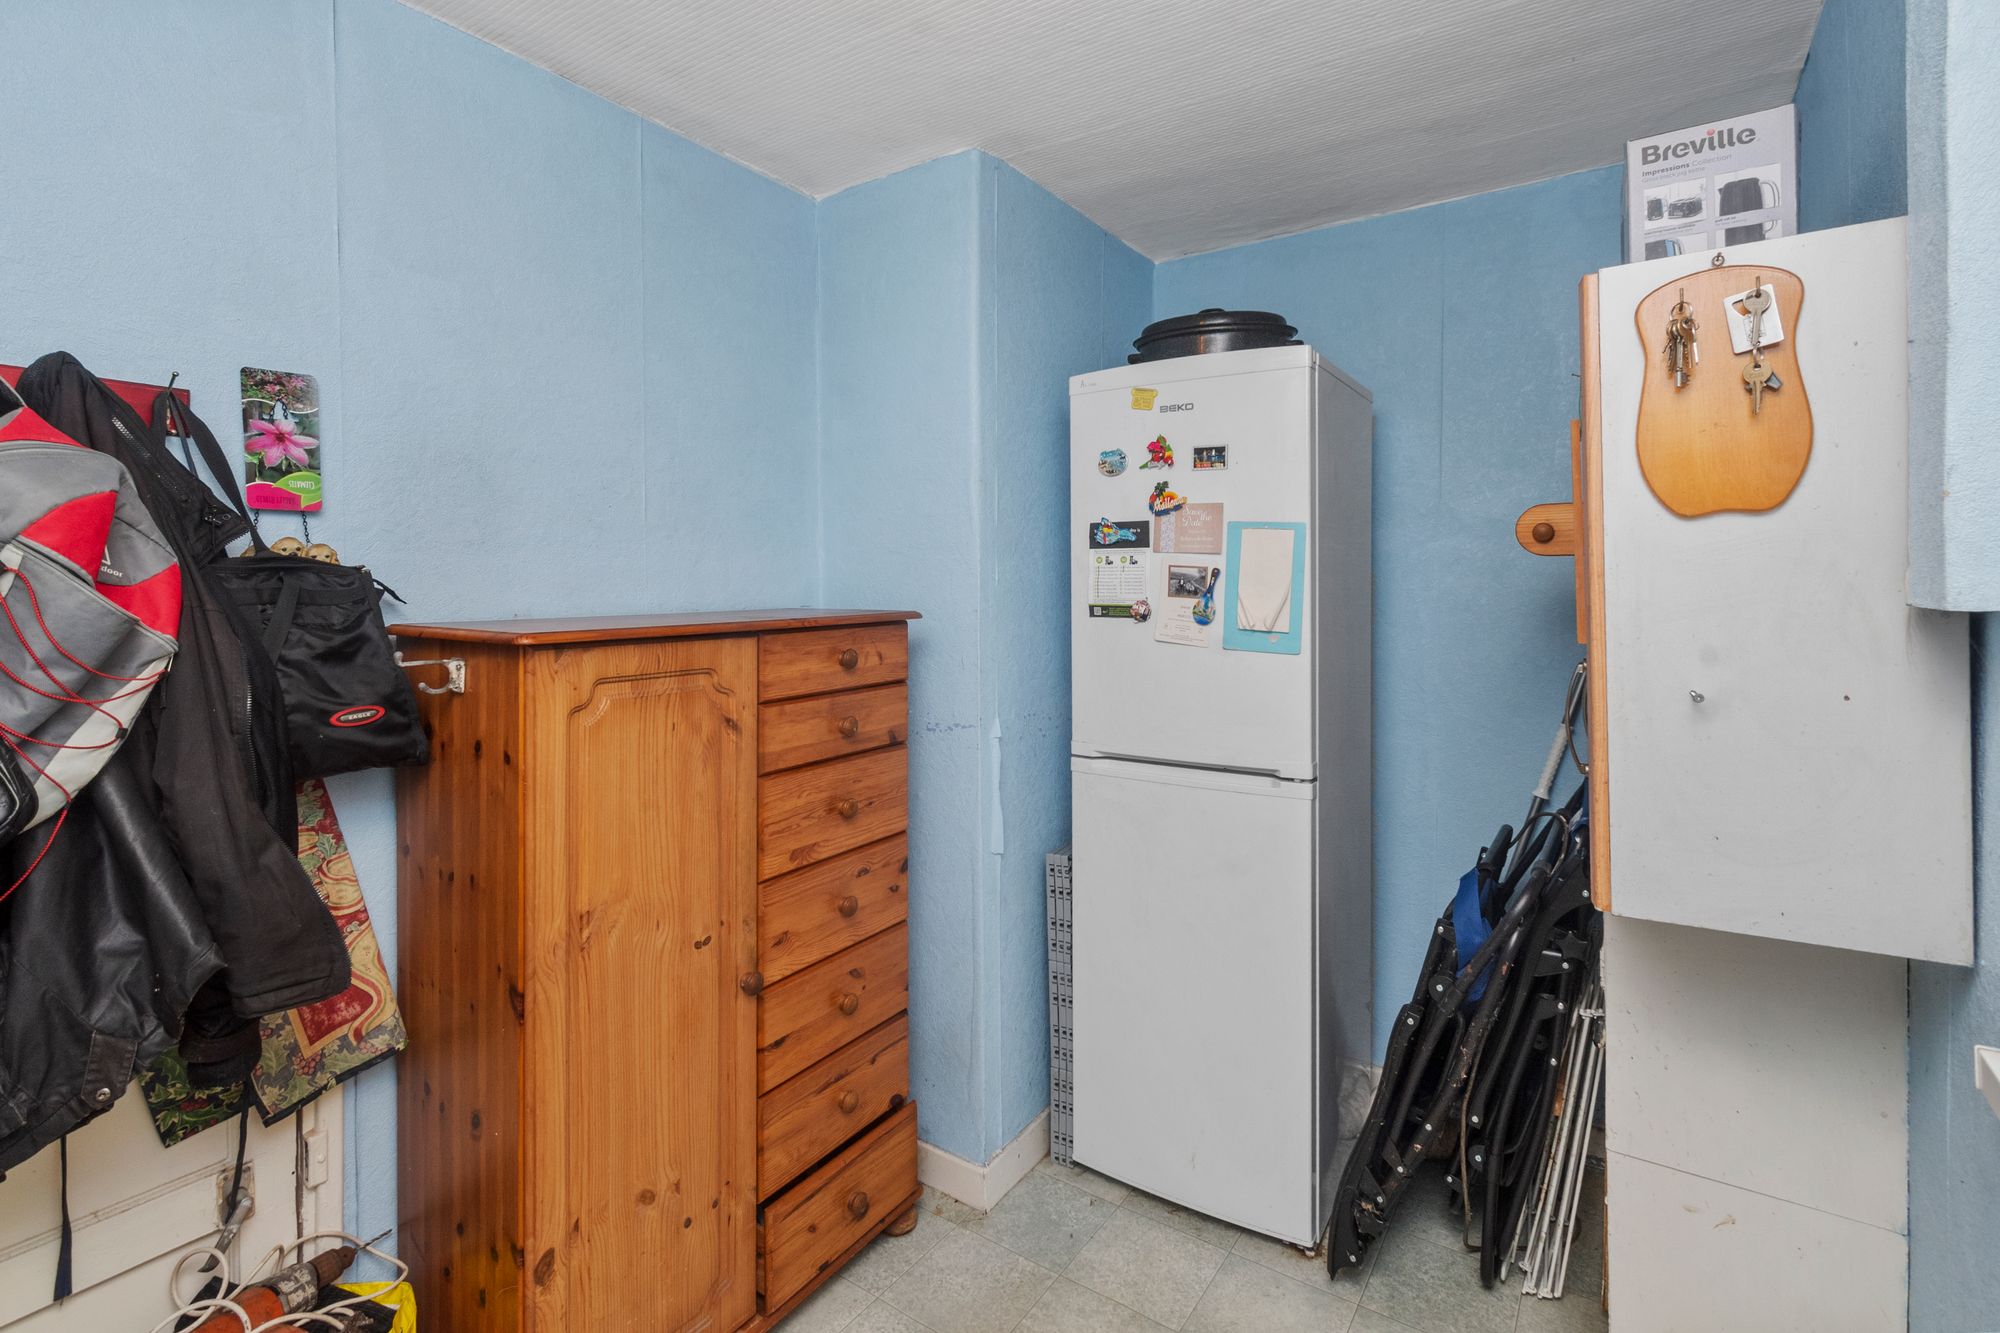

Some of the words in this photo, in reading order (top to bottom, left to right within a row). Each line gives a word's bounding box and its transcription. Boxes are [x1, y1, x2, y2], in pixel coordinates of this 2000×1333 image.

[1642, 128, 1756, 165] Breville
[1642, 162, 1690, 176] Impressions
[1691, 154, 1732, 166] Collection
[1160, 402, 1194, 413] BEKO
[101, 565, 124, 578] door
